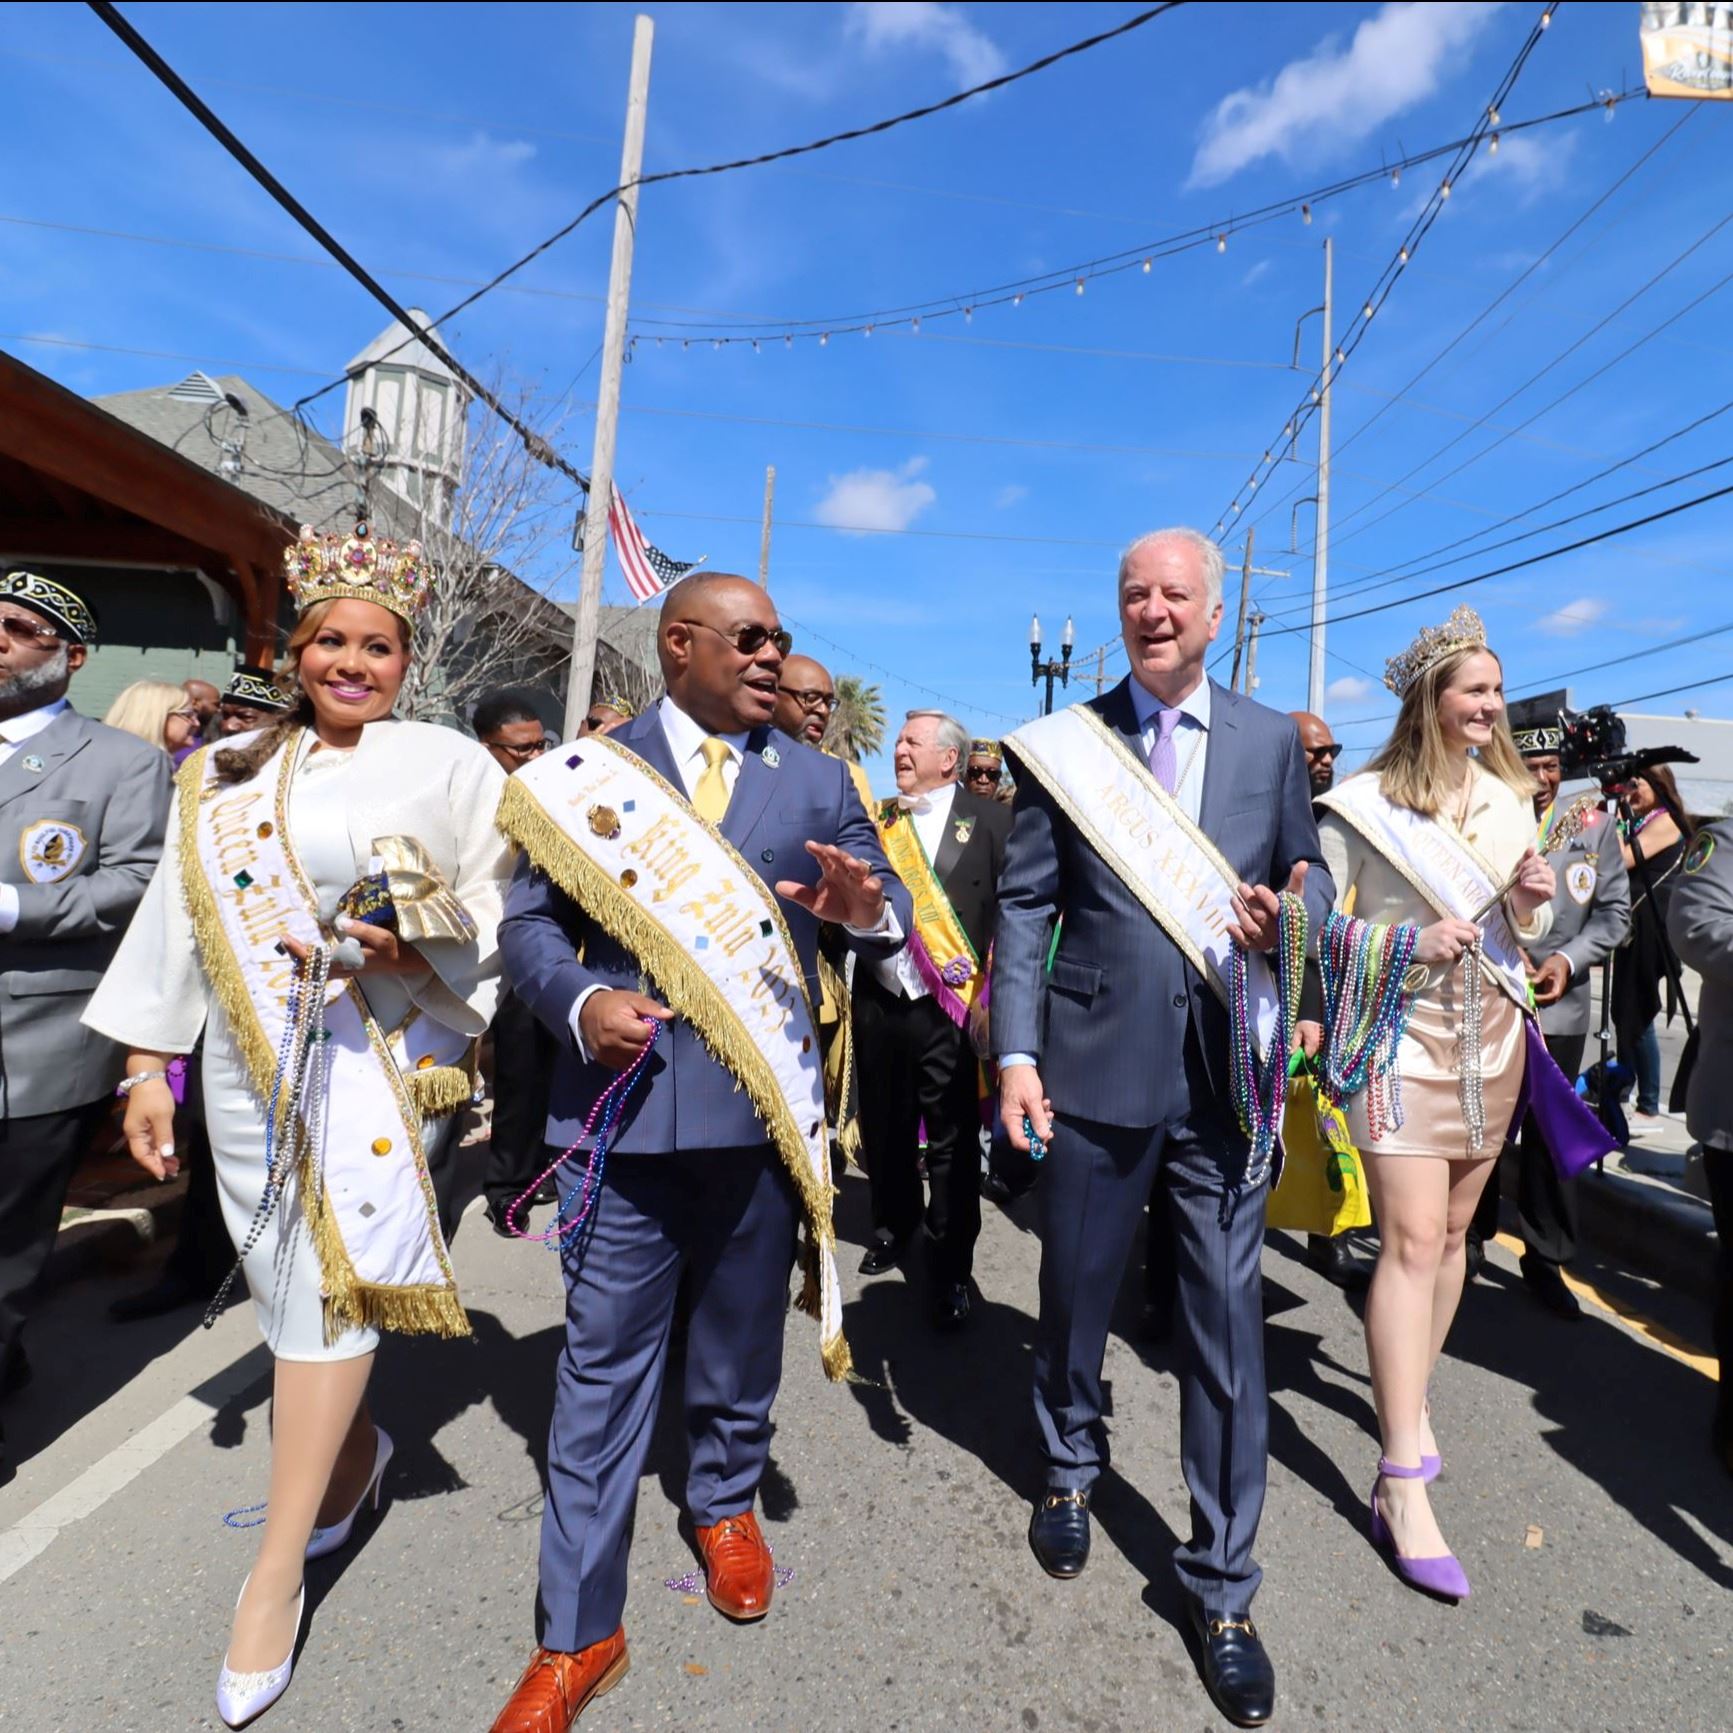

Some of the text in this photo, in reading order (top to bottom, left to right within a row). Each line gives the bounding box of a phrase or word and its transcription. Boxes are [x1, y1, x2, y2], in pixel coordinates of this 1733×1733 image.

[1098, 783, 1160, 849] ARGUS
[1413, 831, 1463, 882] QUEEN
[208, 792, 299, 947] Queen Zulu
[620, 813, 702, 903] King
[680, 880, 756, 957] Zulu
